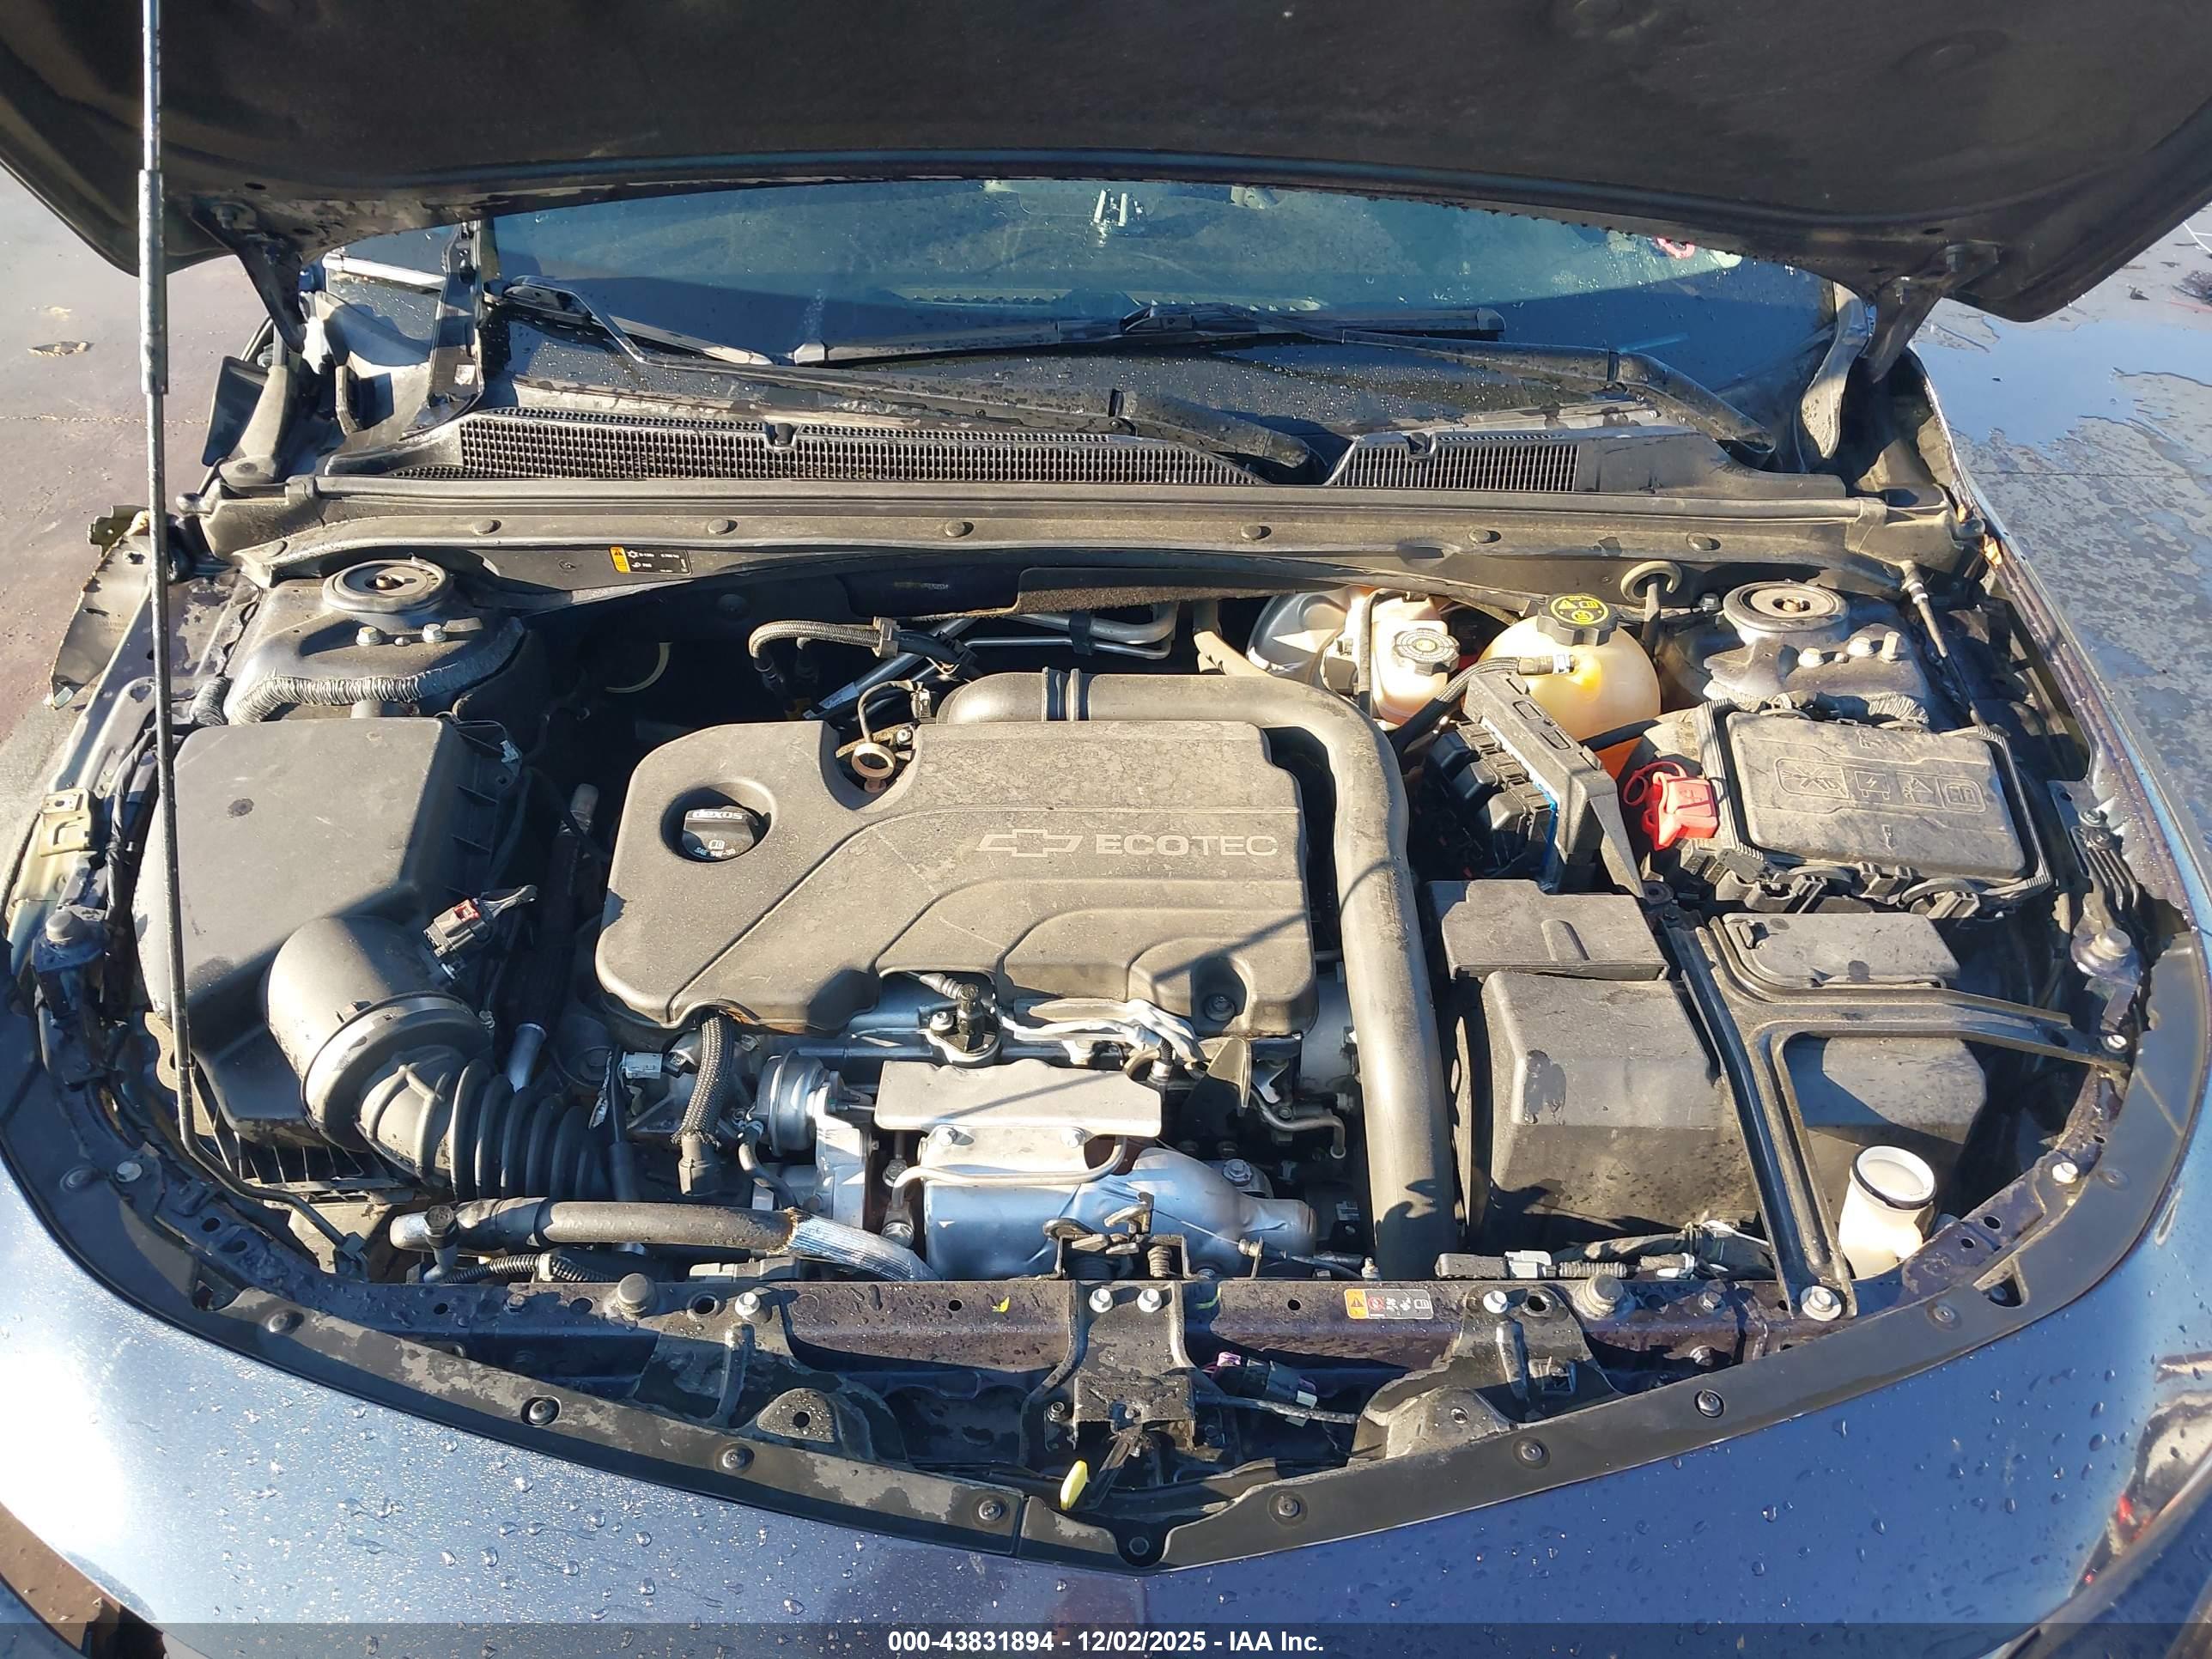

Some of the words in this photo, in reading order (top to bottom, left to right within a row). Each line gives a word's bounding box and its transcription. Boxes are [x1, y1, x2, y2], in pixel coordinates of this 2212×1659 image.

[692, 809, 743, 820] dexos
[1095, 834, 1279, 857] ECOTEC
[694, 847, 708, 856] SAE
